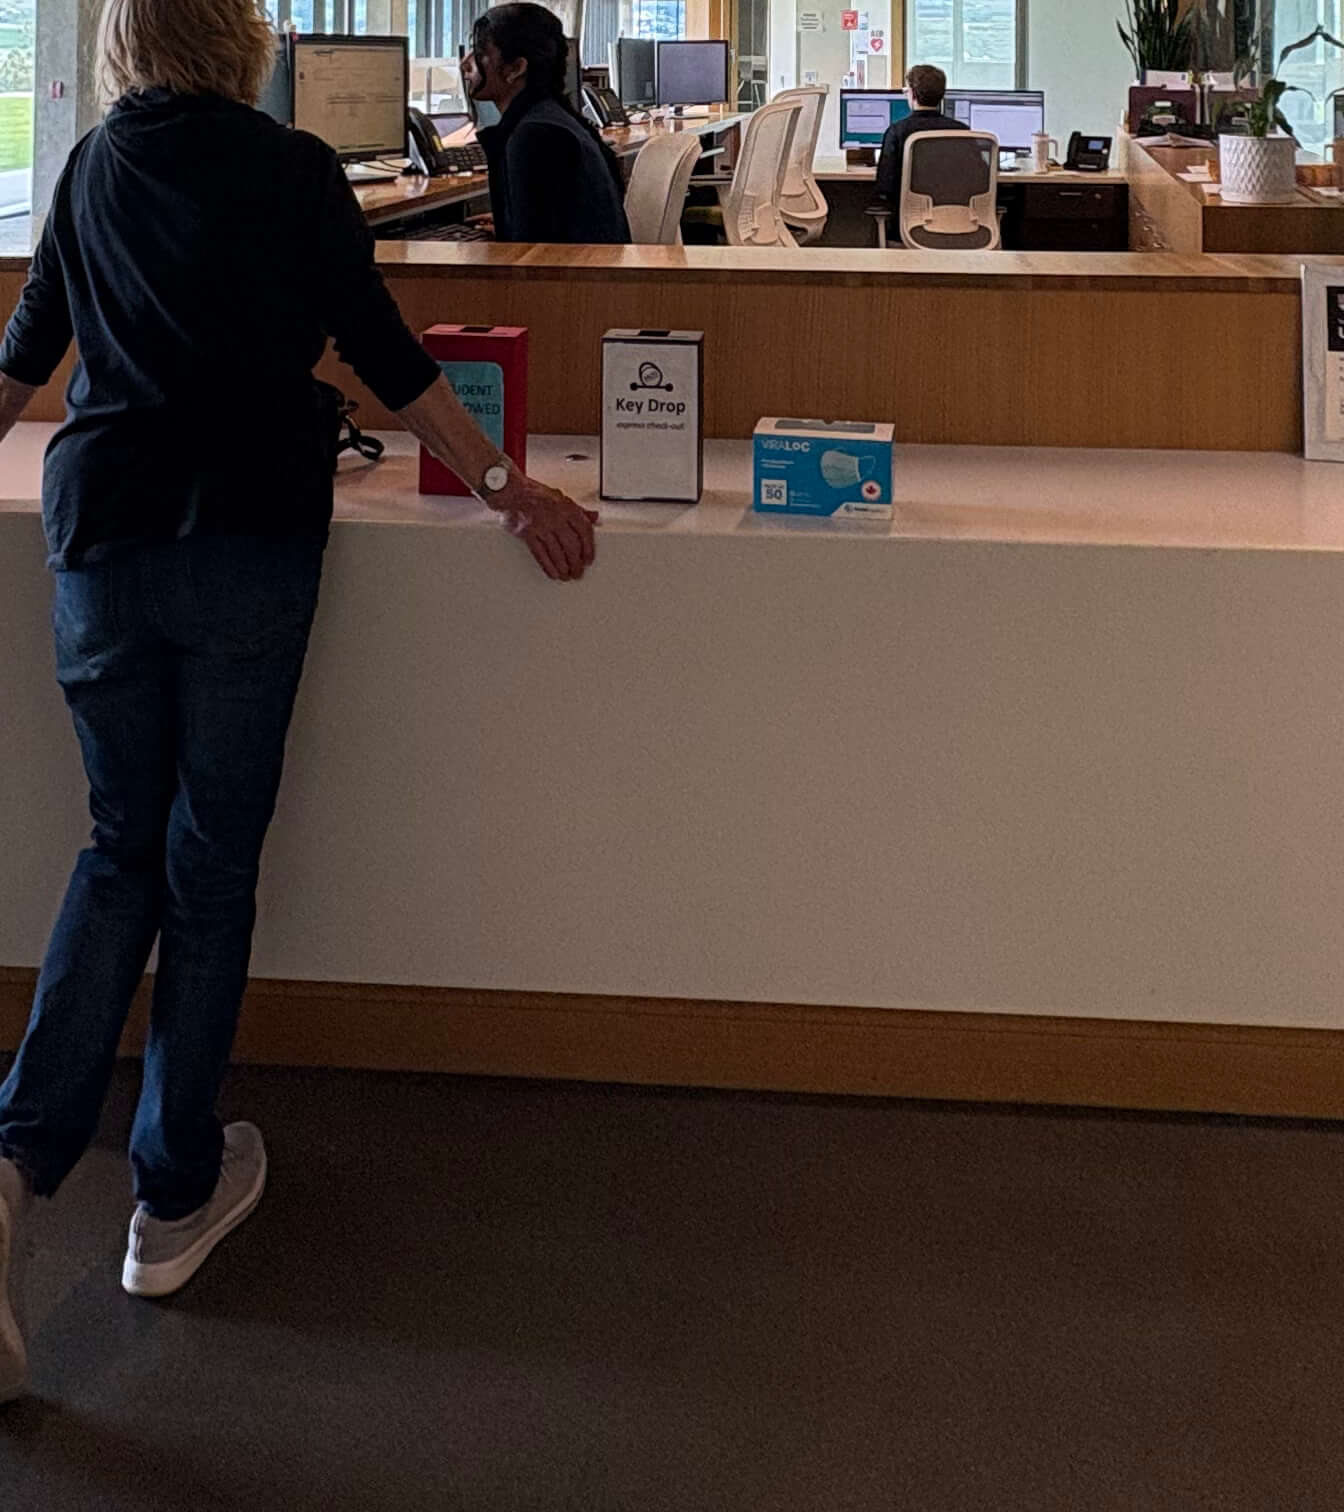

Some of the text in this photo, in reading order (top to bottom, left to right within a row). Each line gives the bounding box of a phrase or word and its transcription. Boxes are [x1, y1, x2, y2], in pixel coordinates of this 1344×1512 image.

[451, 384, 494, 396] UDENT
[616, 398, 686, 416] Key Drop
